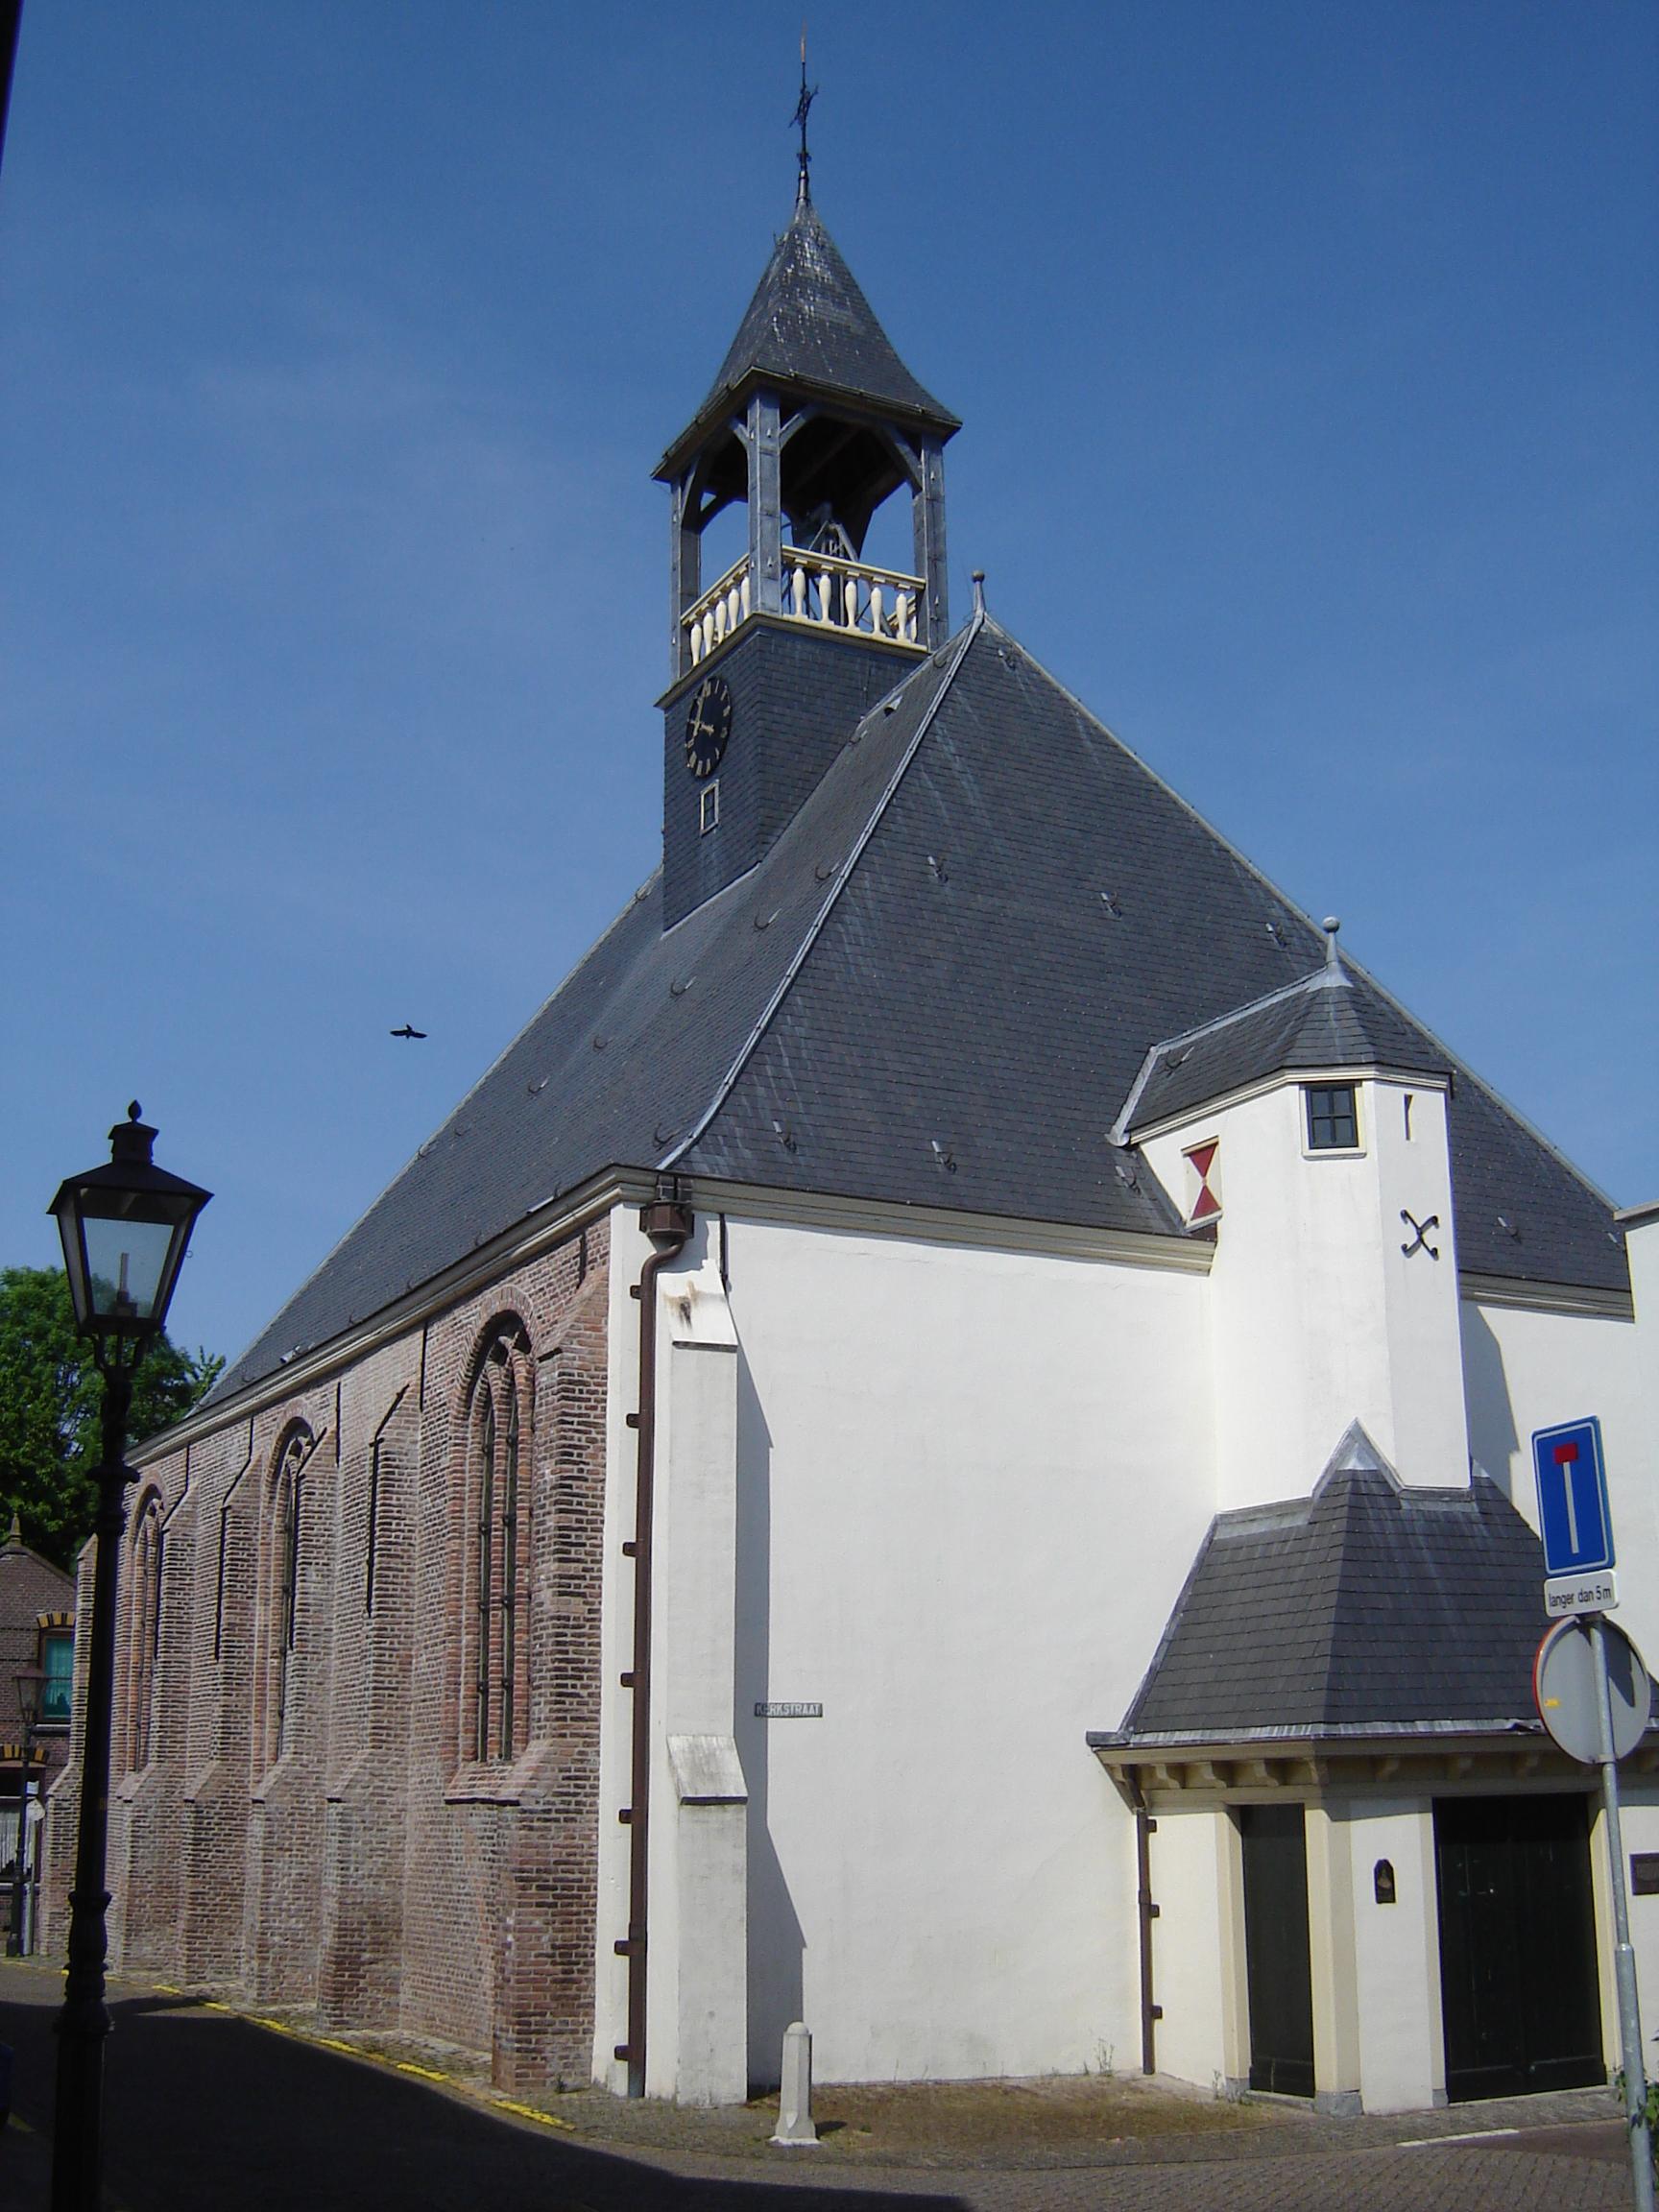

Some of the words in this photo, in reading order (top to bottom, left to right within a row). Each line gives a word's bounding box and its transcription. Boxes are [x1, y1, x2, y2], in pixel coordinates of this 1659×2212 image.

[1548, 1593, 1575, 1609] langer
[1577, 1587, 1595, 1603] dan
[756, 1703, 821, 1717] KERKSTRAAT
